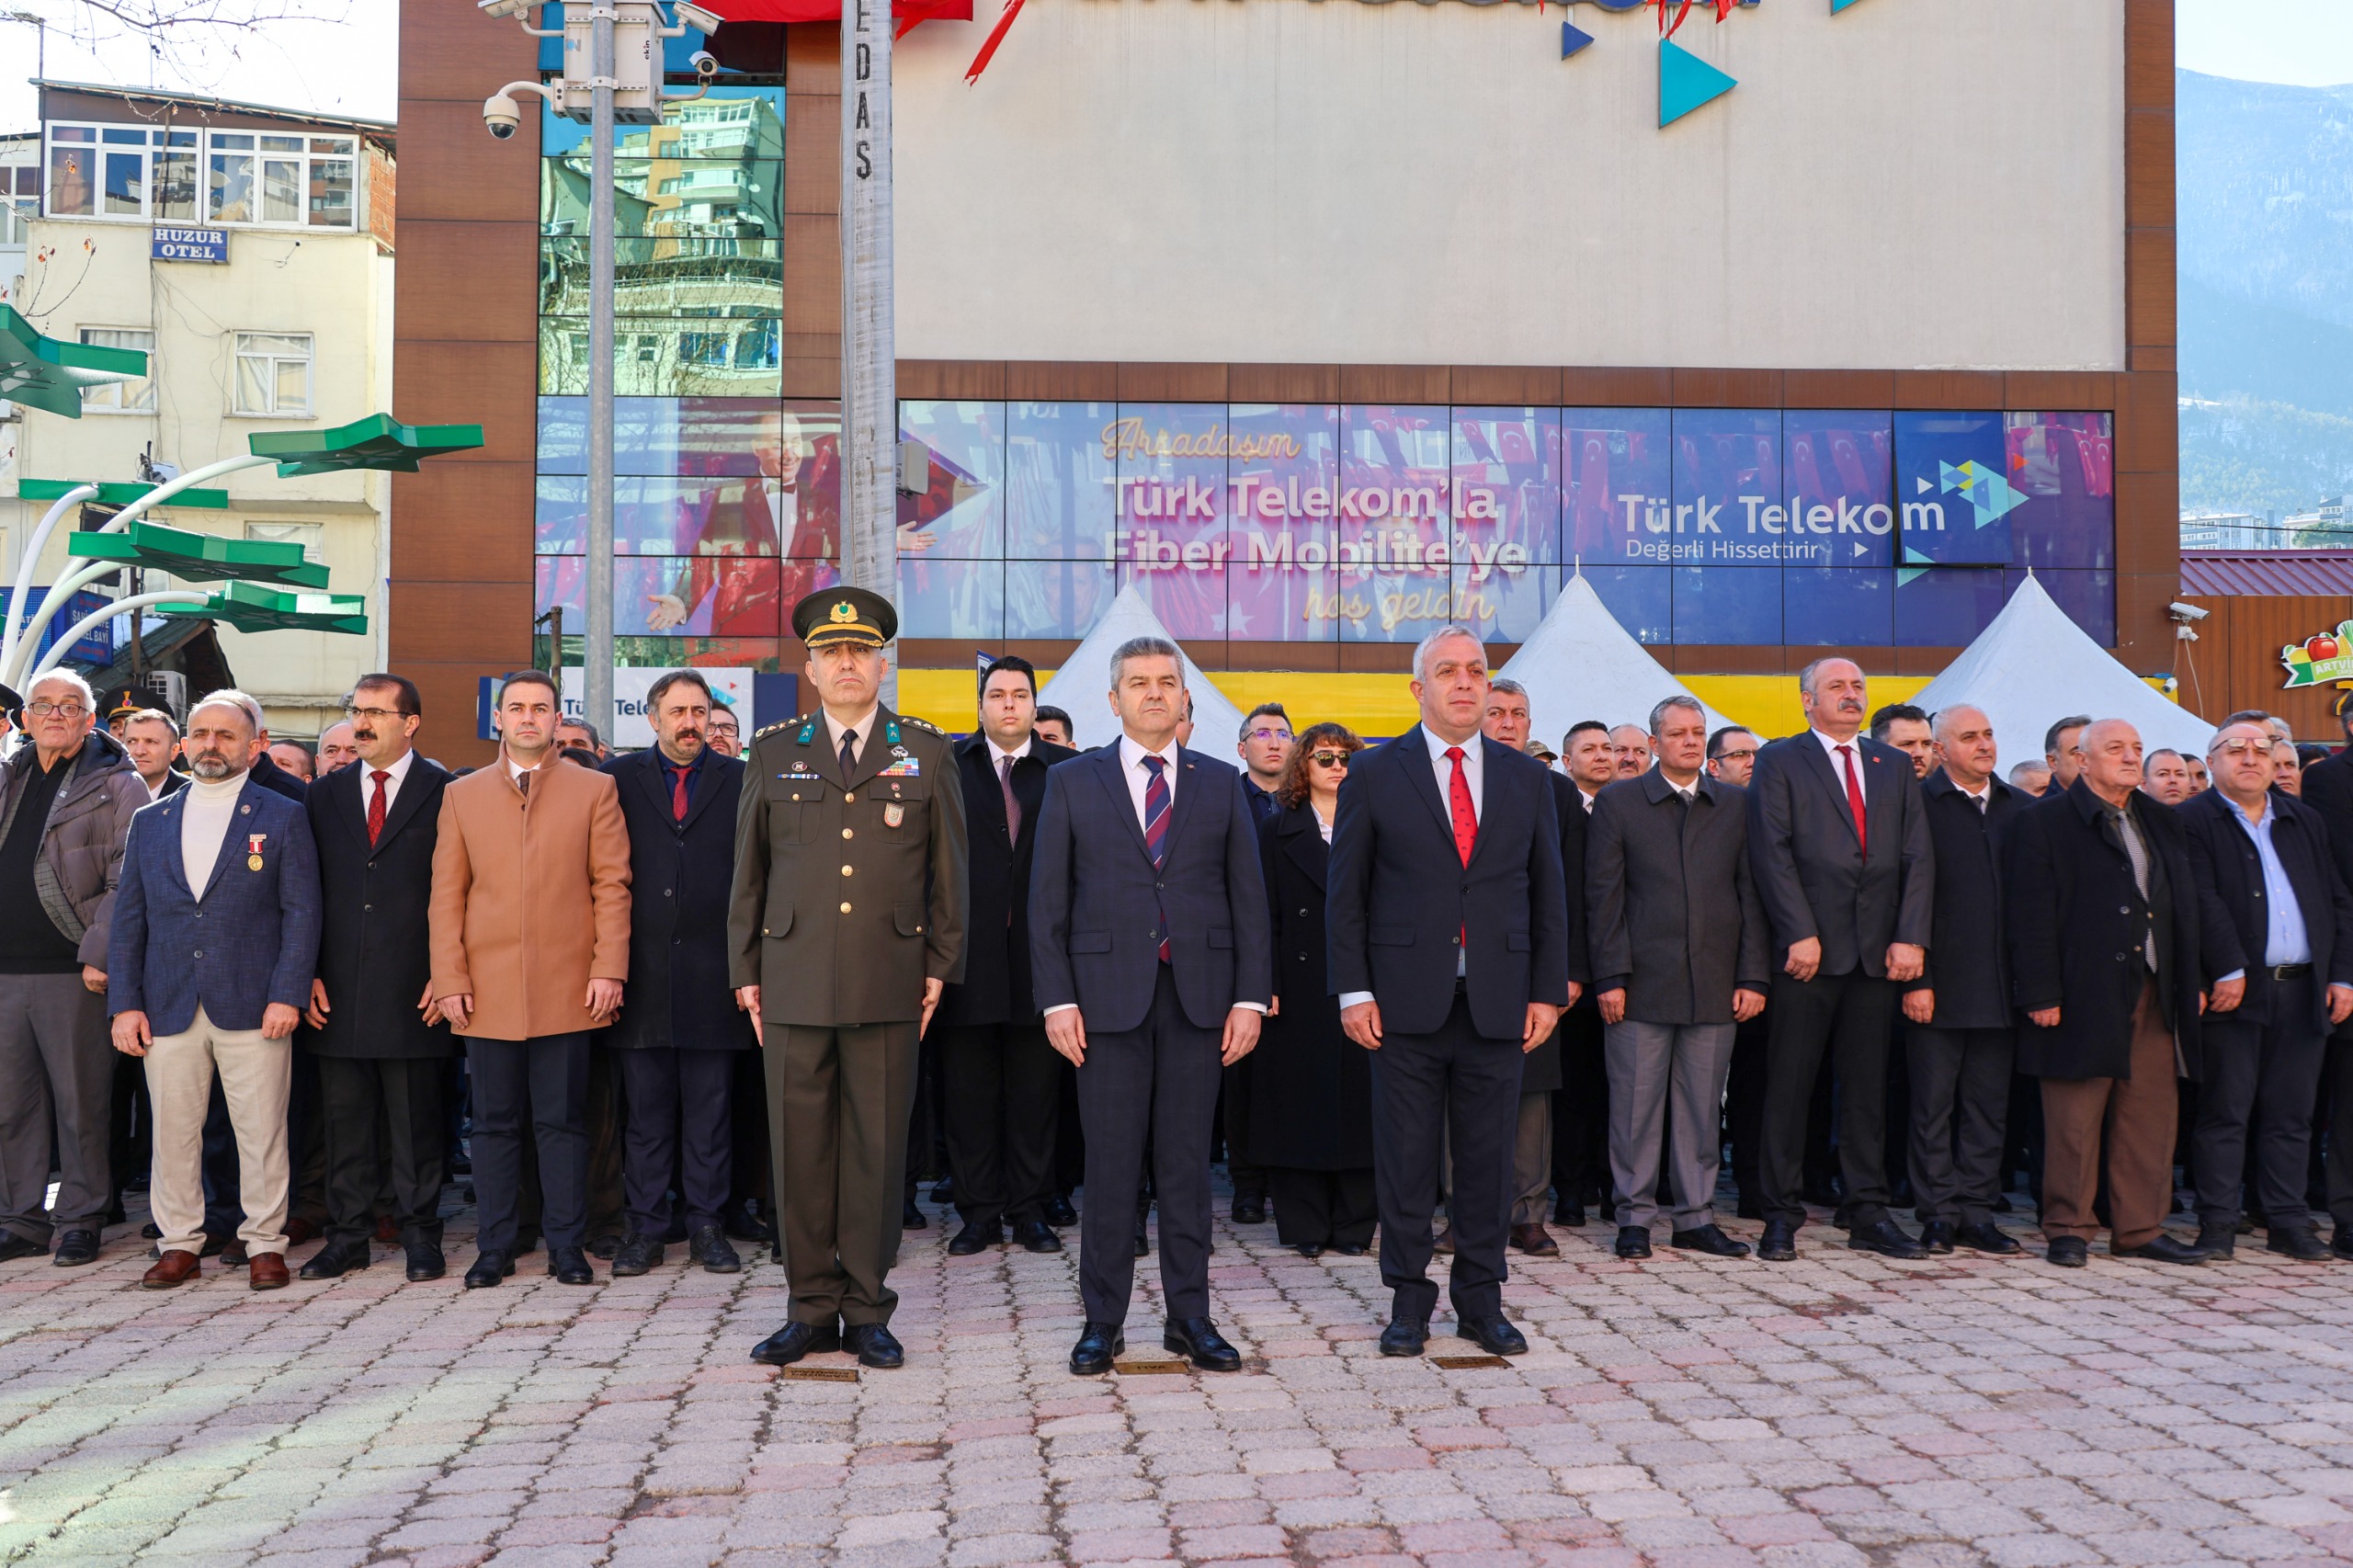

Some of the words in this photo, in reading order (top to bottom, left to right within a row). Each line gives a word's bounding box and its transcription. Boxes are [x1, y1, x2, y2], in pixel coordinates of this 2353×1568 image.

[154, 228, 223, 244] HUZUR
[161, 244, 215, 258] OTEL
[1103, 475, 1216, 517] Türk
[1618, 494, 1723, 534] Türk
[1738, 494, 1945, 536] Telekom
[1106, 529, 1233, 571] Fiber
[1626, 540, 1704, 562] Değerli
[1712, 541, 1819, 560] Hissettirir
[1381, 584, 1495, 631] geldin
[94, 630, 109, 644] BAYİ
[2315, 657, 2353, 676] ARTVİ
